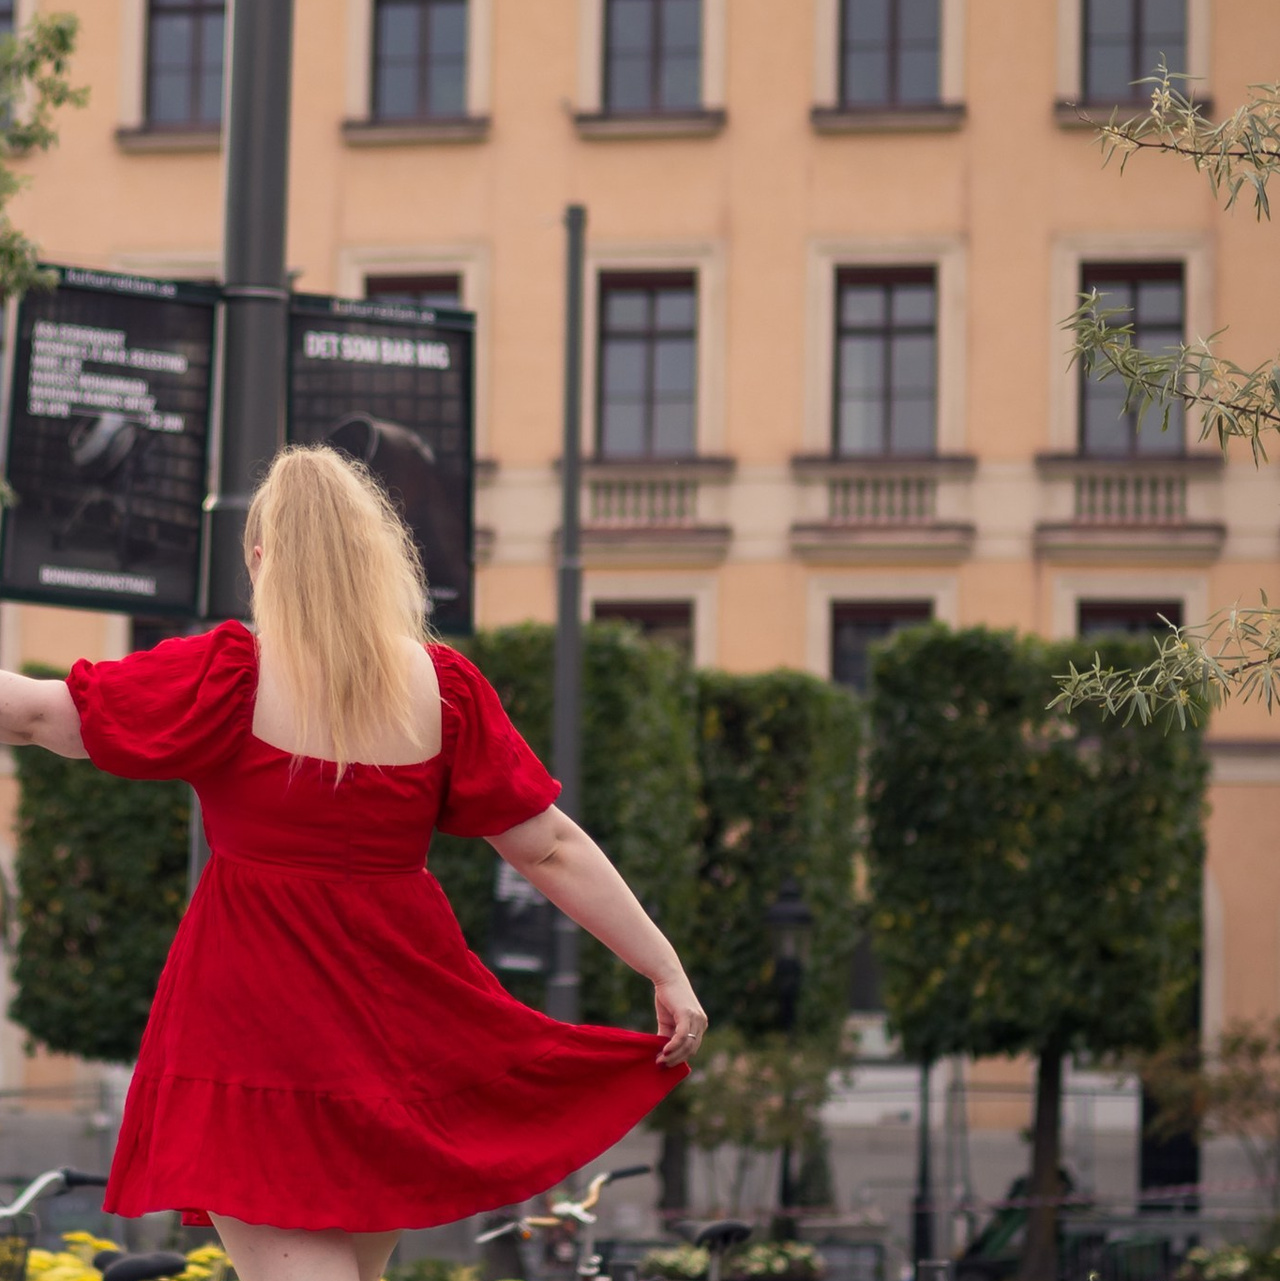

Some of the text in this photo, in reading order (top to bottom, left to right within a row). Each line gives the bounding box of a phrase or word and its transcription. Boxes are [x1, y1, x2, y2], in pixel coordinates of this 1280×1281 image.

[66, 268, 176, 297] kulturreklam.se
[332, 300, 435, 323] kulturreklam.se
[304, 330, 339, 359] DET
[340, 333, 379, 362] SOM
[416, 340, 450, 369] MIG
